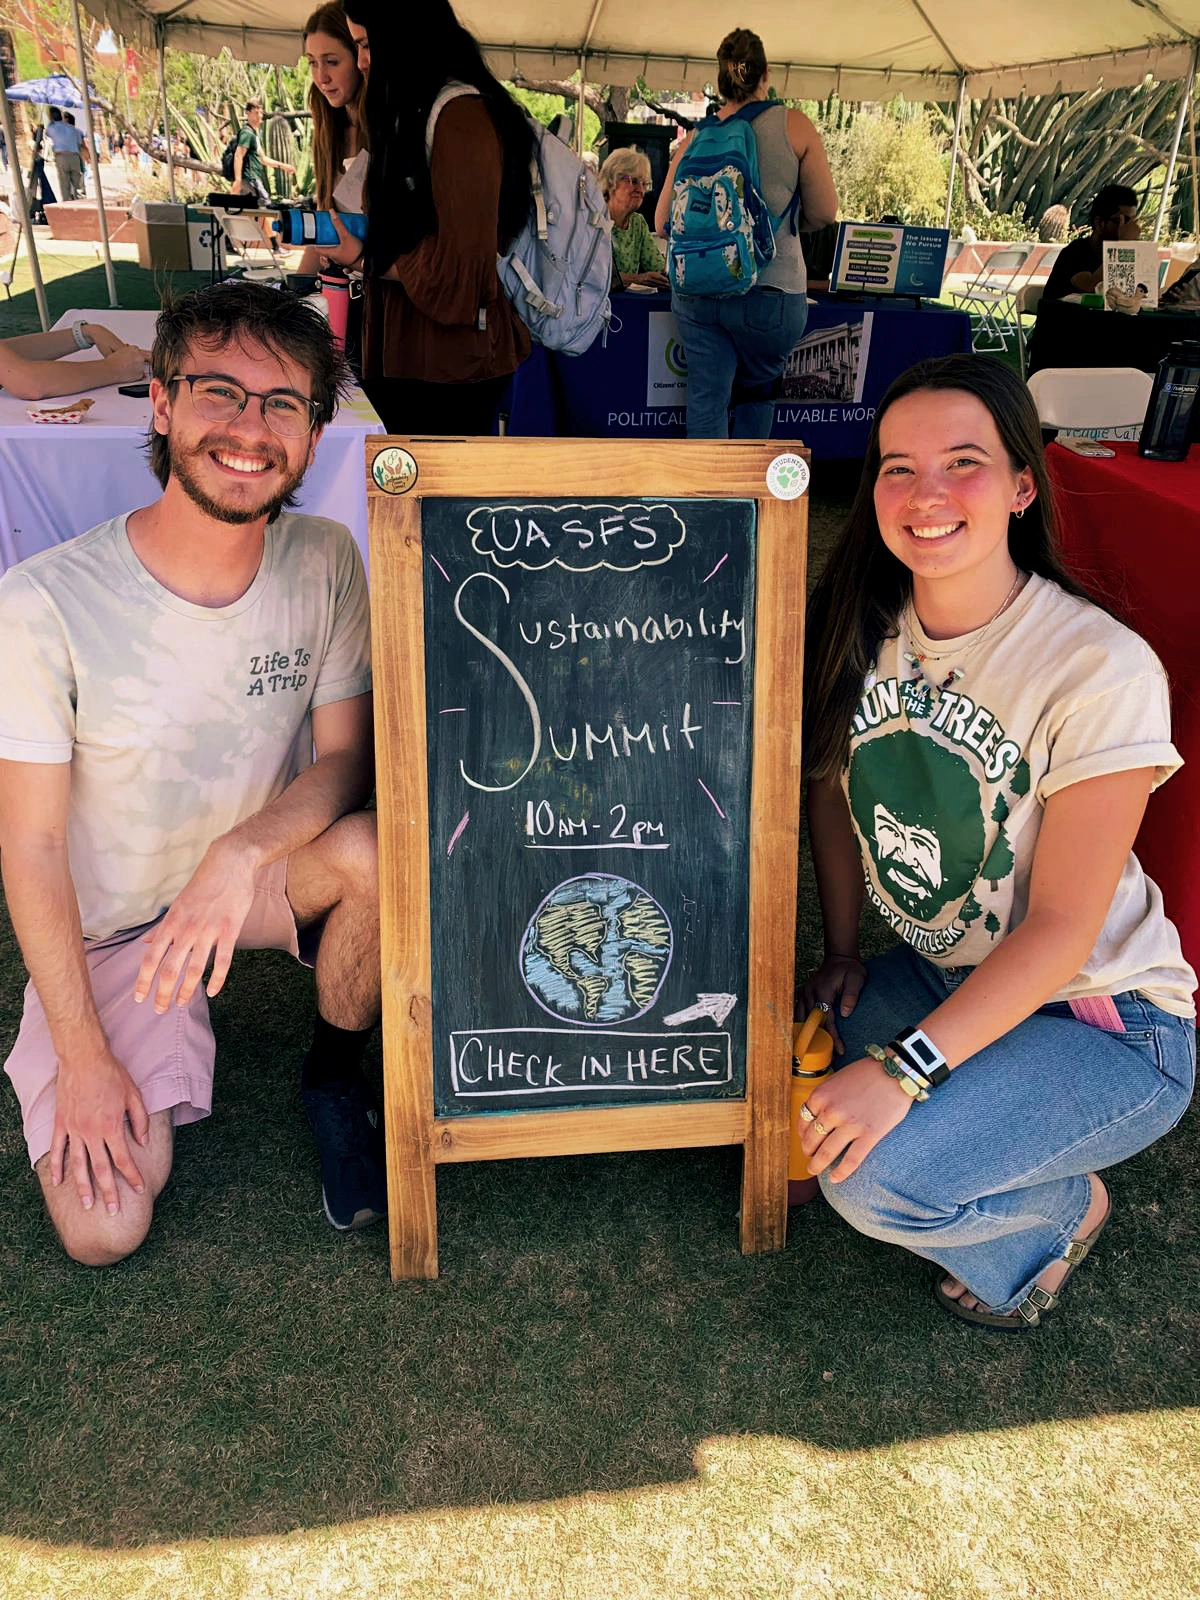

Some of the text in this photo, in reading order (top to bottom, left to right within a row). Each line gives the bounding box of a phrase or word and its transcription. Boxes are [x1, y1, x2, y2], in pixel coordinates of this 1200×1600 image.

[607, 411, 687, 427] POLITICAL
[776, 407, 877, 423] LIVABLE WOR
[772, 457, 803, 471] STUDENTS
[491, 514, 657, 551] UA SFS
[250, 647, 311, 675] Life Is
[246, 669, 308, 696] A Trip
[902, 696, 926, 715] THE
[930, 689, 1021, 783] TREES
[901, 919, 947, 954] LITTLE
[458, 1037, 721, 1086] CHECK IN HERE
